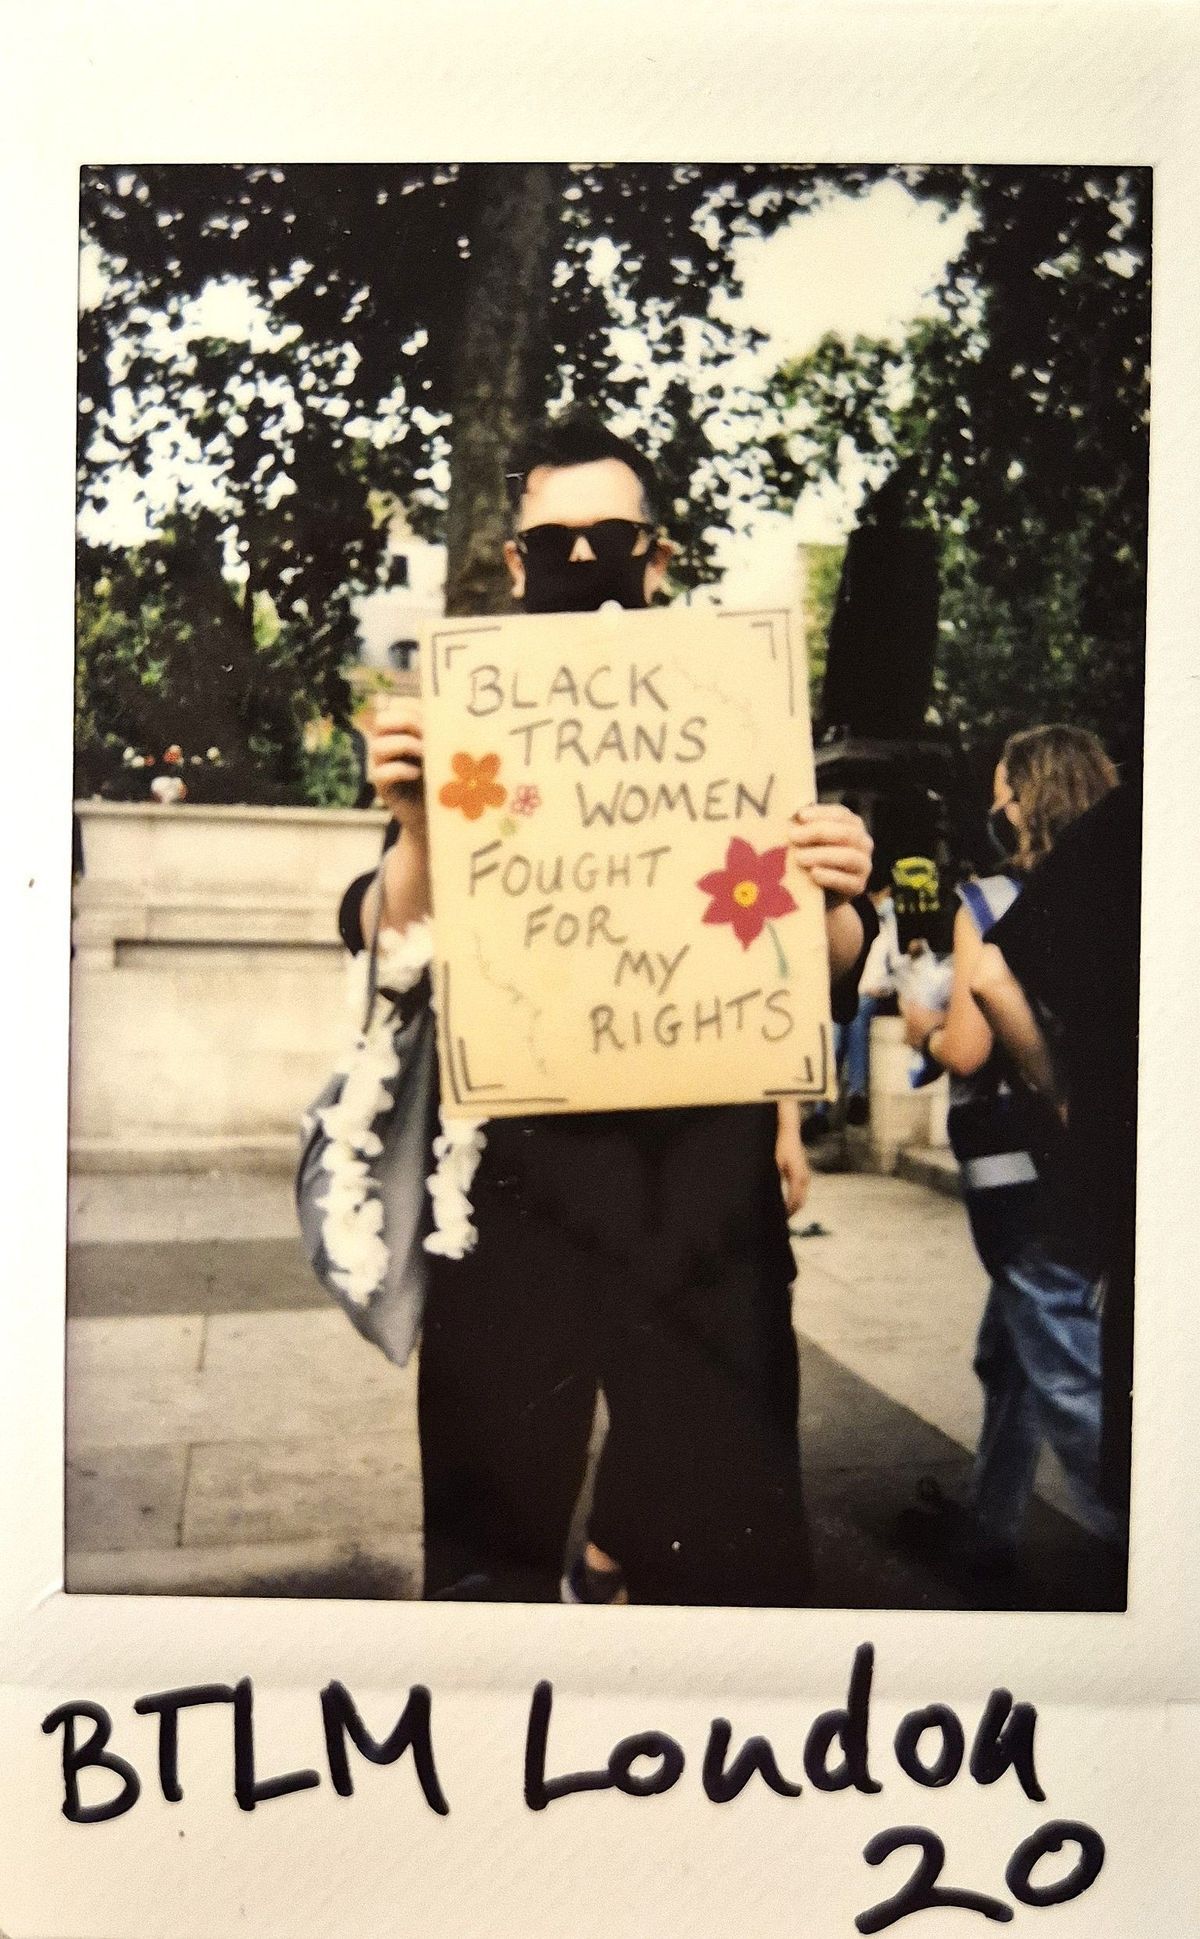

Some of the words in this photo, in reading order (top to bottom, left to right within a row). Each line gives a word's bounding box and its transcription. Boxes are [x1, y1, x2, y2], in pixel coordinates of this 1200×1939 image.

[467, 664, 669, 717] BLACK
[509, 717, 708, 767] TRANS
[576, 775, 775, 828] WOMEN
[469, 840, 672, 896] FOUGHT
[523, 904, 628, 948] FOR
[614, 944, 691, 995] MY
[589, 988, 796, 1054] RIGHTS
[41, 1675, 451, 1823] BTLM
[522, 1640, 1046, 1816] London
[854, 1819, 1106, 1935] 20
